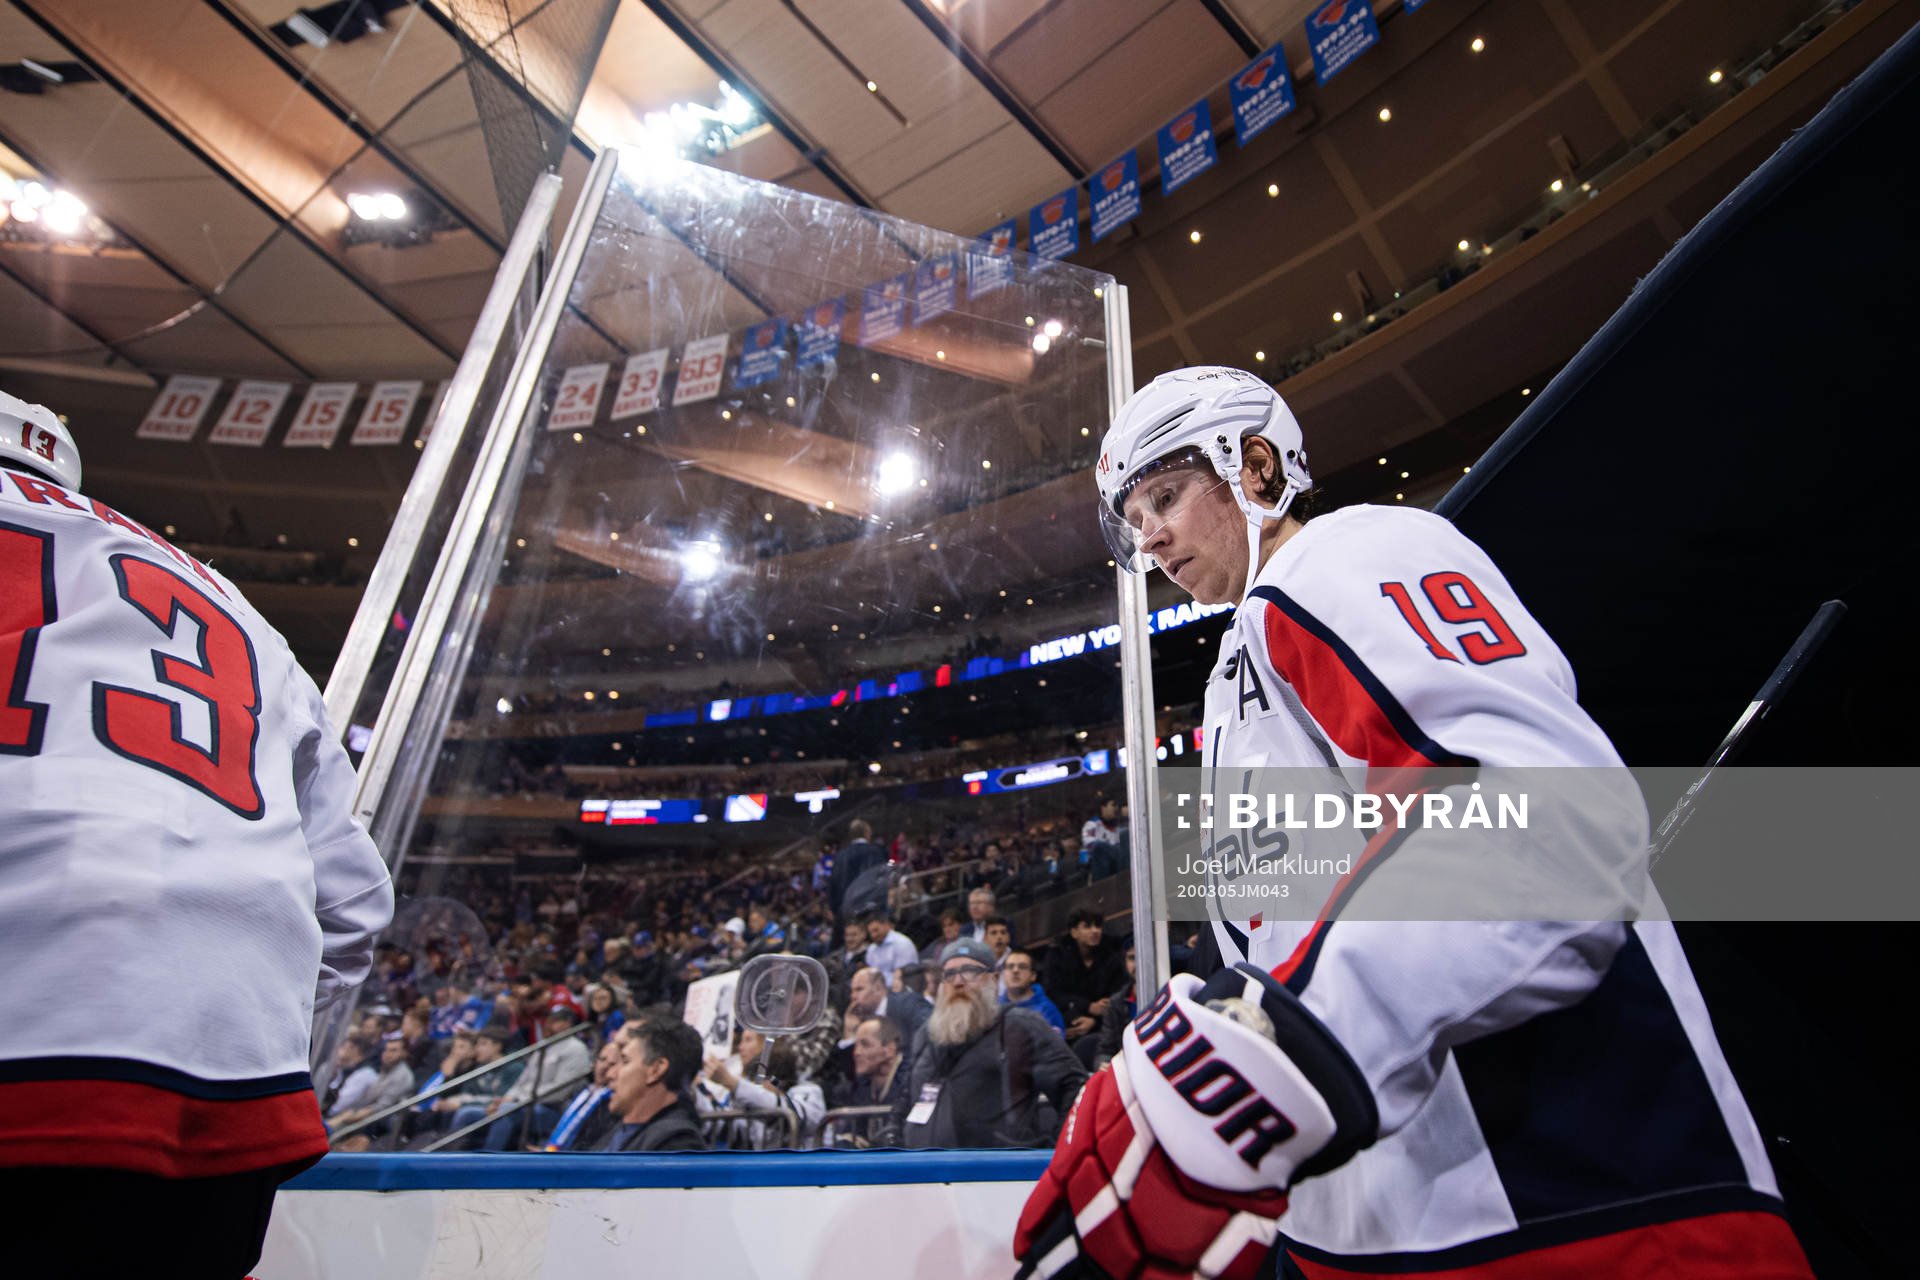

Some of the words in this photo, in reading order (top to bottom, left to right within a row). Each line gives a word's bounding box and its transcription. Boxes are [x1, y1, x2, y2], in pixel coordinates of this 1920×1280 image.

[559, 383, 597, 409] 24
[623, 368, 658, 397] 33
[160, 394, 202, 419] 10
[231, 400, 271, 424] 12
[304, 401, 341, 425] 15
[370, 399, 407, 424] 15
[21, 421, 57, 462] 13
[1379, 571, 1527, 665] 19
[1030, 633, 1086, 665] NEW
[1238, 643, 1271, 722] A
